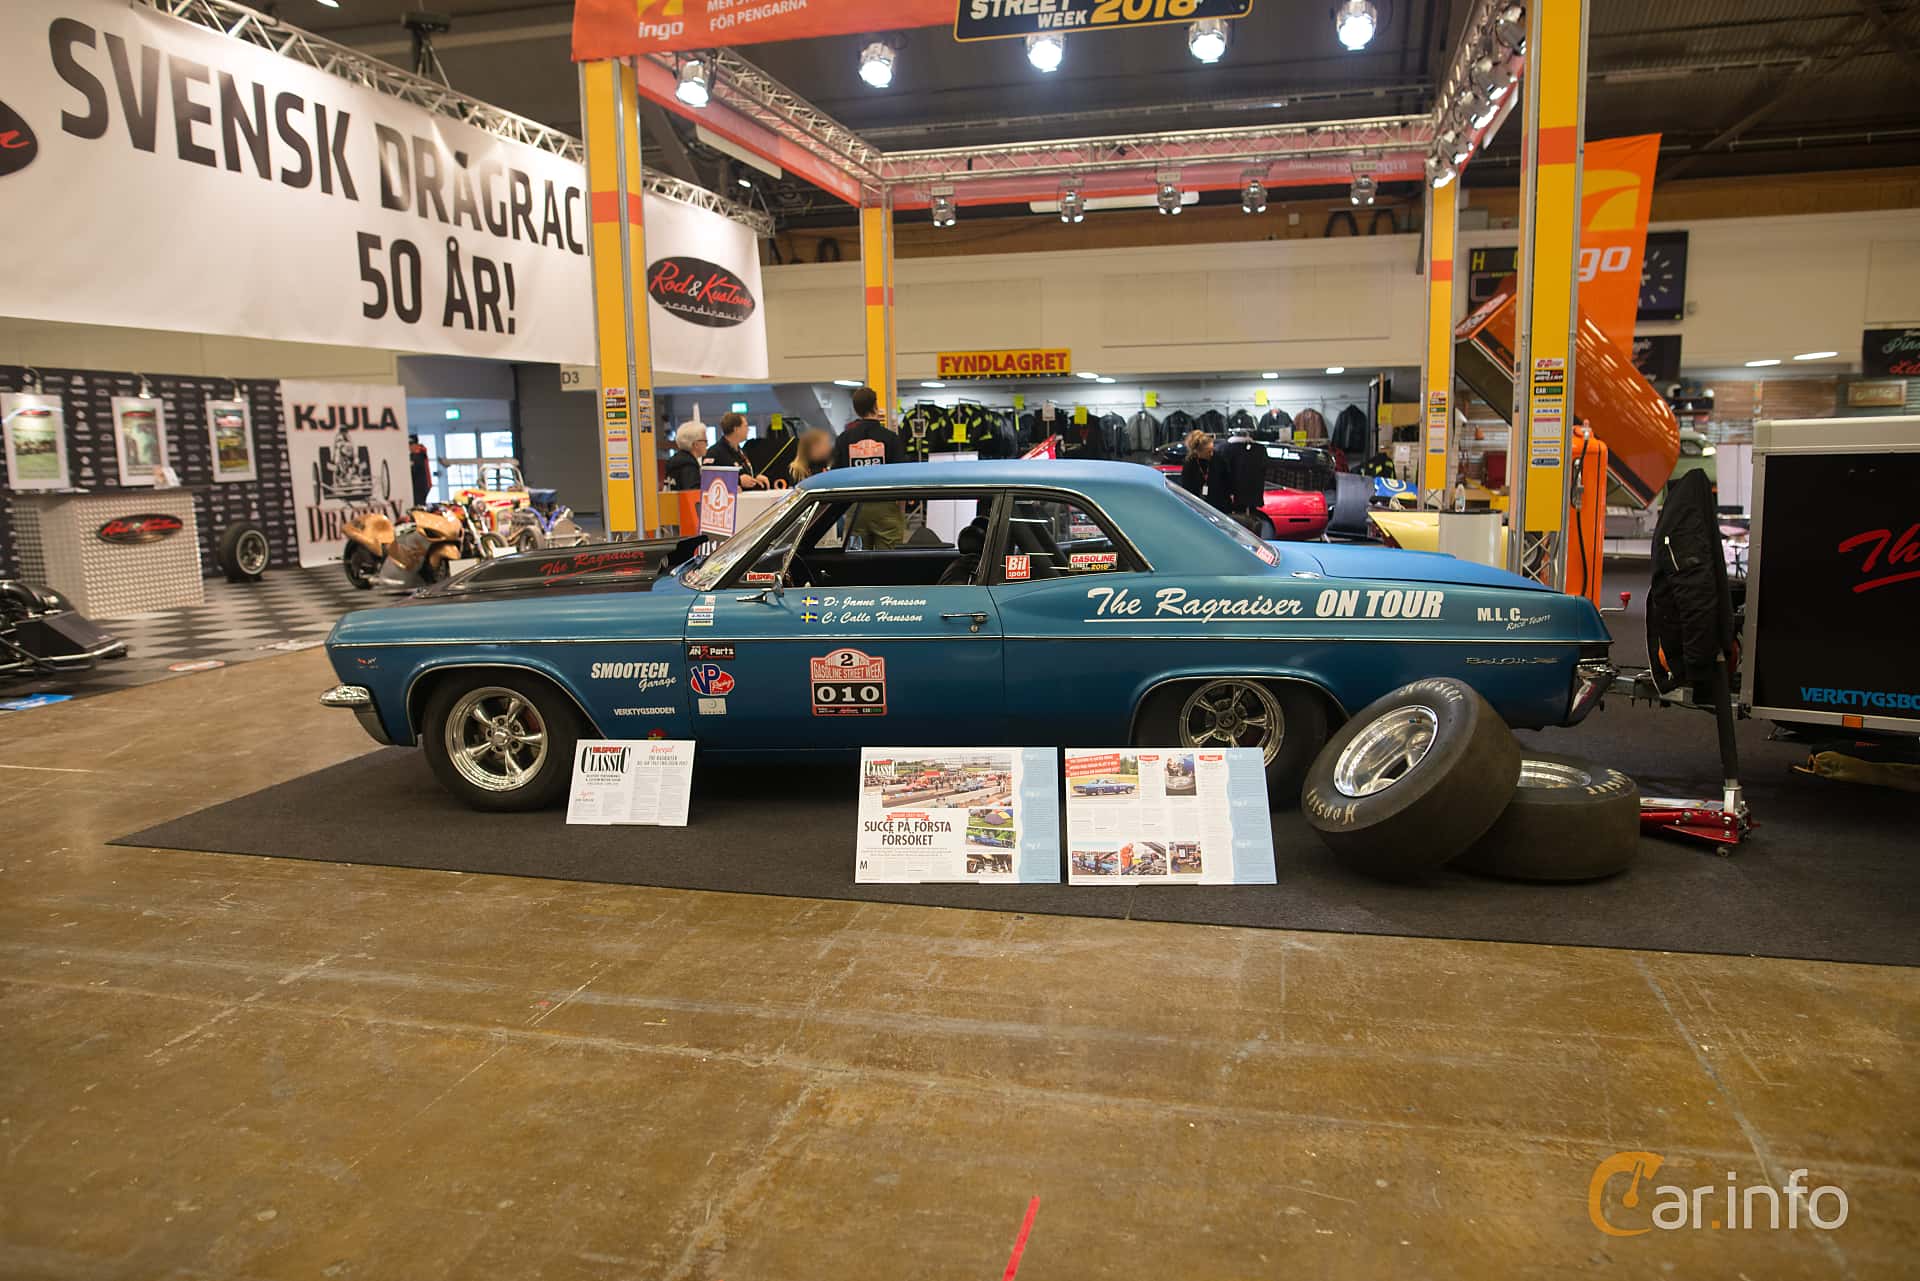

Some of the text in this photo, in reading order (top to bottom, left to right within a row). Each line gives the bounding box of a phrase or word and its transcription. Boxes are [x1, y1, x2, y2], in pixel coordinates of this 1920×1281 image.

[1038, 9, 1088, 29] WEEK
[638, 21, 684, 41] ingo
[47, 17, 591, 257] SVENSK DRAGRAC
[356, 231, 516, 335] 50 ÅR!
[939, 352, 1067, 373] FYNDLAGRET
[561, 371, 580, 385] D3
[293, 404, 400, 431] KJULA
[1007, 557, 1027, 571] Bil
[1071, 554, 1117, 564] GASOLINE
[842, 596, 875, 609] Janne
[880, 595, 927, 607] Hansson
[1087, 587, 1445, 624] The Ragraiser ON TOUR
[840, 611, 871, 624] Calle
[876, 611, 922, 623] Hansson
[841, 653, 854, 666] 2
[591, 662, 670, 679] SMOOTECH
[638, 676, 677, 692] Garage
[690, 664, 720, 695] VP
[817, 685, 880, 702] 010
[1800, 686, 1920, 710] VERKTYGSBO
[581, 746, 632, 774] CLASSIC
[914, 818, 952, 832] FÖRSTA
[882, 831, 934, 846] FÖRSÖKET
